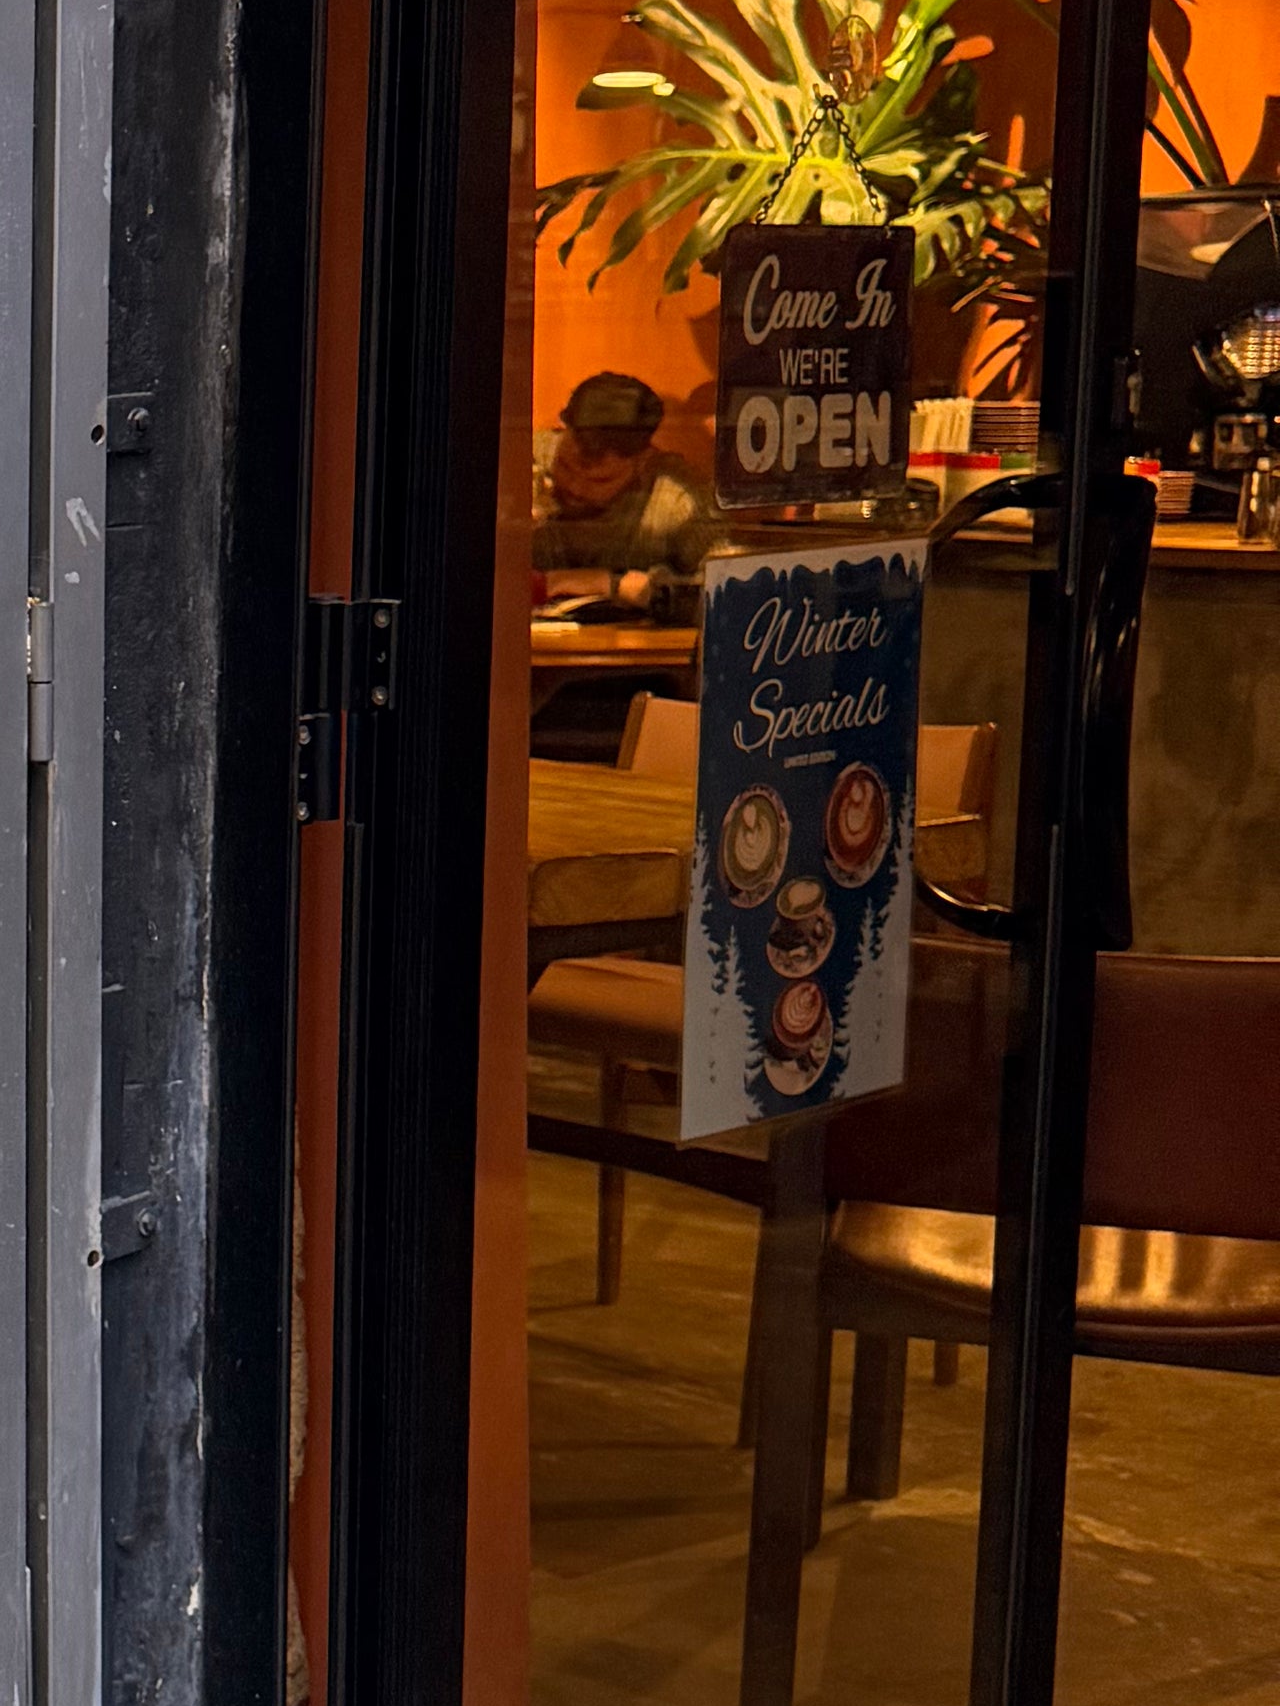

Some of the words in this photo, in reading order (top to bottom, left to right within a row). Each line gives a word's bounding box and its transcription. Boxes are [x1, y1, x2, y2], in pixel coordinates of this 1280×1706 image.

[743, 254, 838, 345] Come
[845, 258, 896, 330] In
[779, 348, 849, 385] WE'RE
[736, 391, 891, 473] OPEN
[744, 597, 886, 674] Winter
[733, 677, 889, 758] Specials
